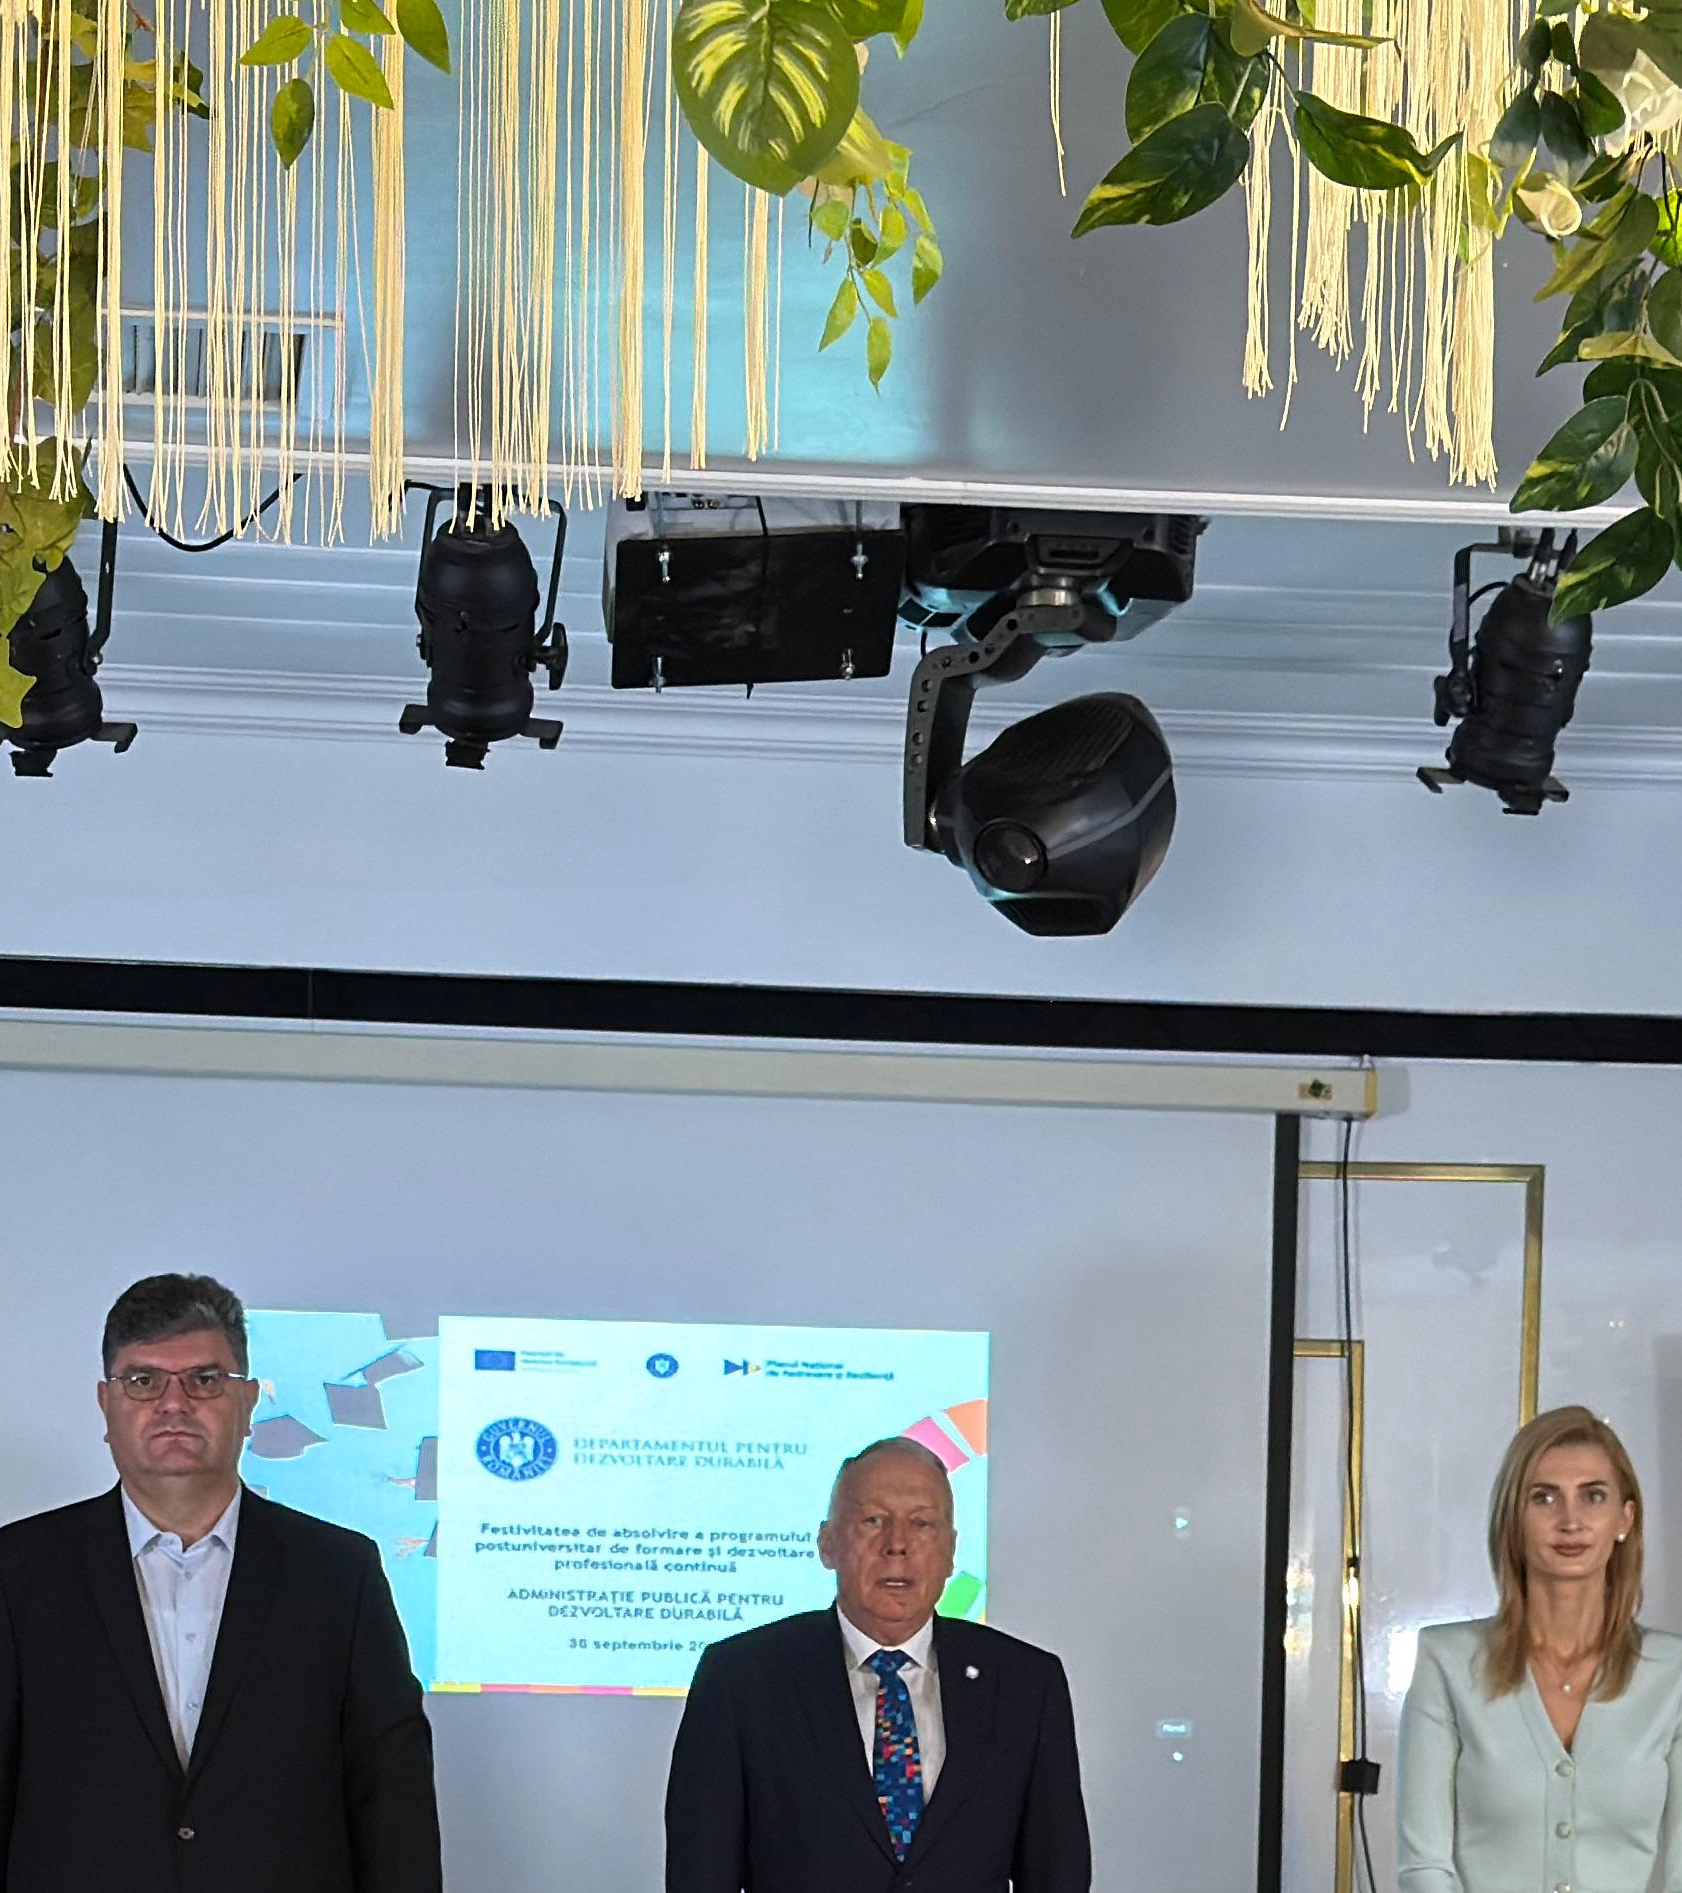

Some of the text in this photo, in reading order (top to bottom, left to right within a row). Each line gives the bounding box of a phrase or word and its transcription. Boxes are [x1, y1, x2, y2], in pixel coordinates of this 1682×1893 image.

[573, 1438, 807, 1455] DEPARTAMENTUL PENTRU
[573, 1453, 686, 1466] DEZVOLTARE
[587, 1527, 607, 1539] de
[614, 1528, 688, 1541] absolvire
[610, 1543, 629, 1554] de
[636, 1542, 703, 1556] formare
[727, 1546, 815, 1559] dezvoltare
[718, 1594, 784, 1607] PENTRU
[548, 1605, 654, 1619] DEZVOLTARE
[593, 1639, 684, 1652] septembrie
[689, 1640, 705, 1651] 20
